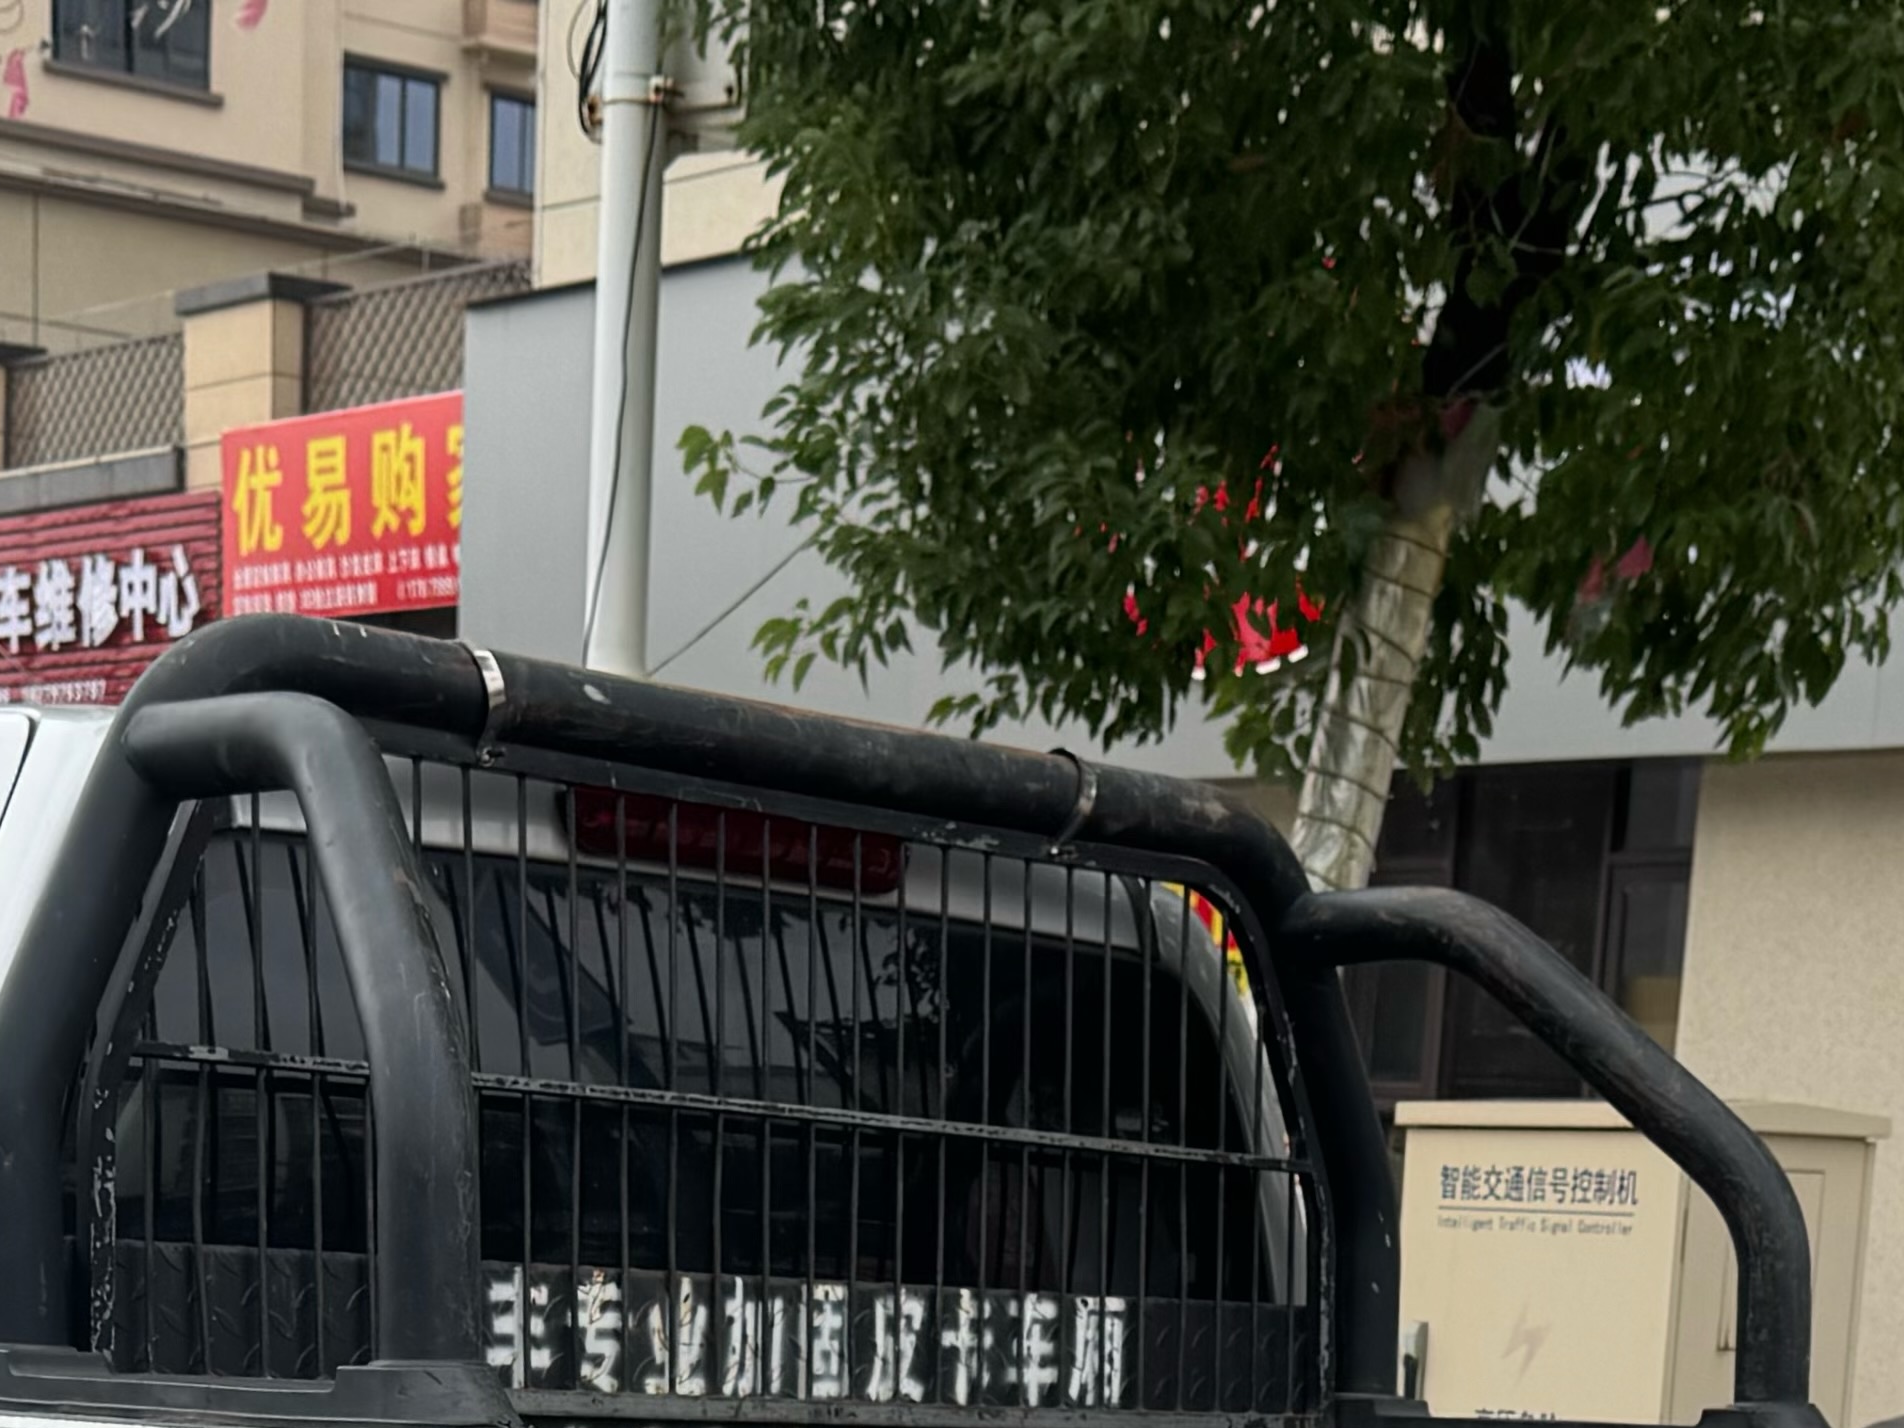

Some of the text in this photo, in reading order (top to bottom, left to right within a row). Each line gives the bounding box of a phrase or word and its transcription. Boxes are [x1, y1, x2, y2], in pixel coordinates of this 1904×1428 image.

[1440, 1164, 1638, 1206] 智能交通信号控制机
[1437, 1215, 1633, 1236] Intelligent Traffic Signal Controller
